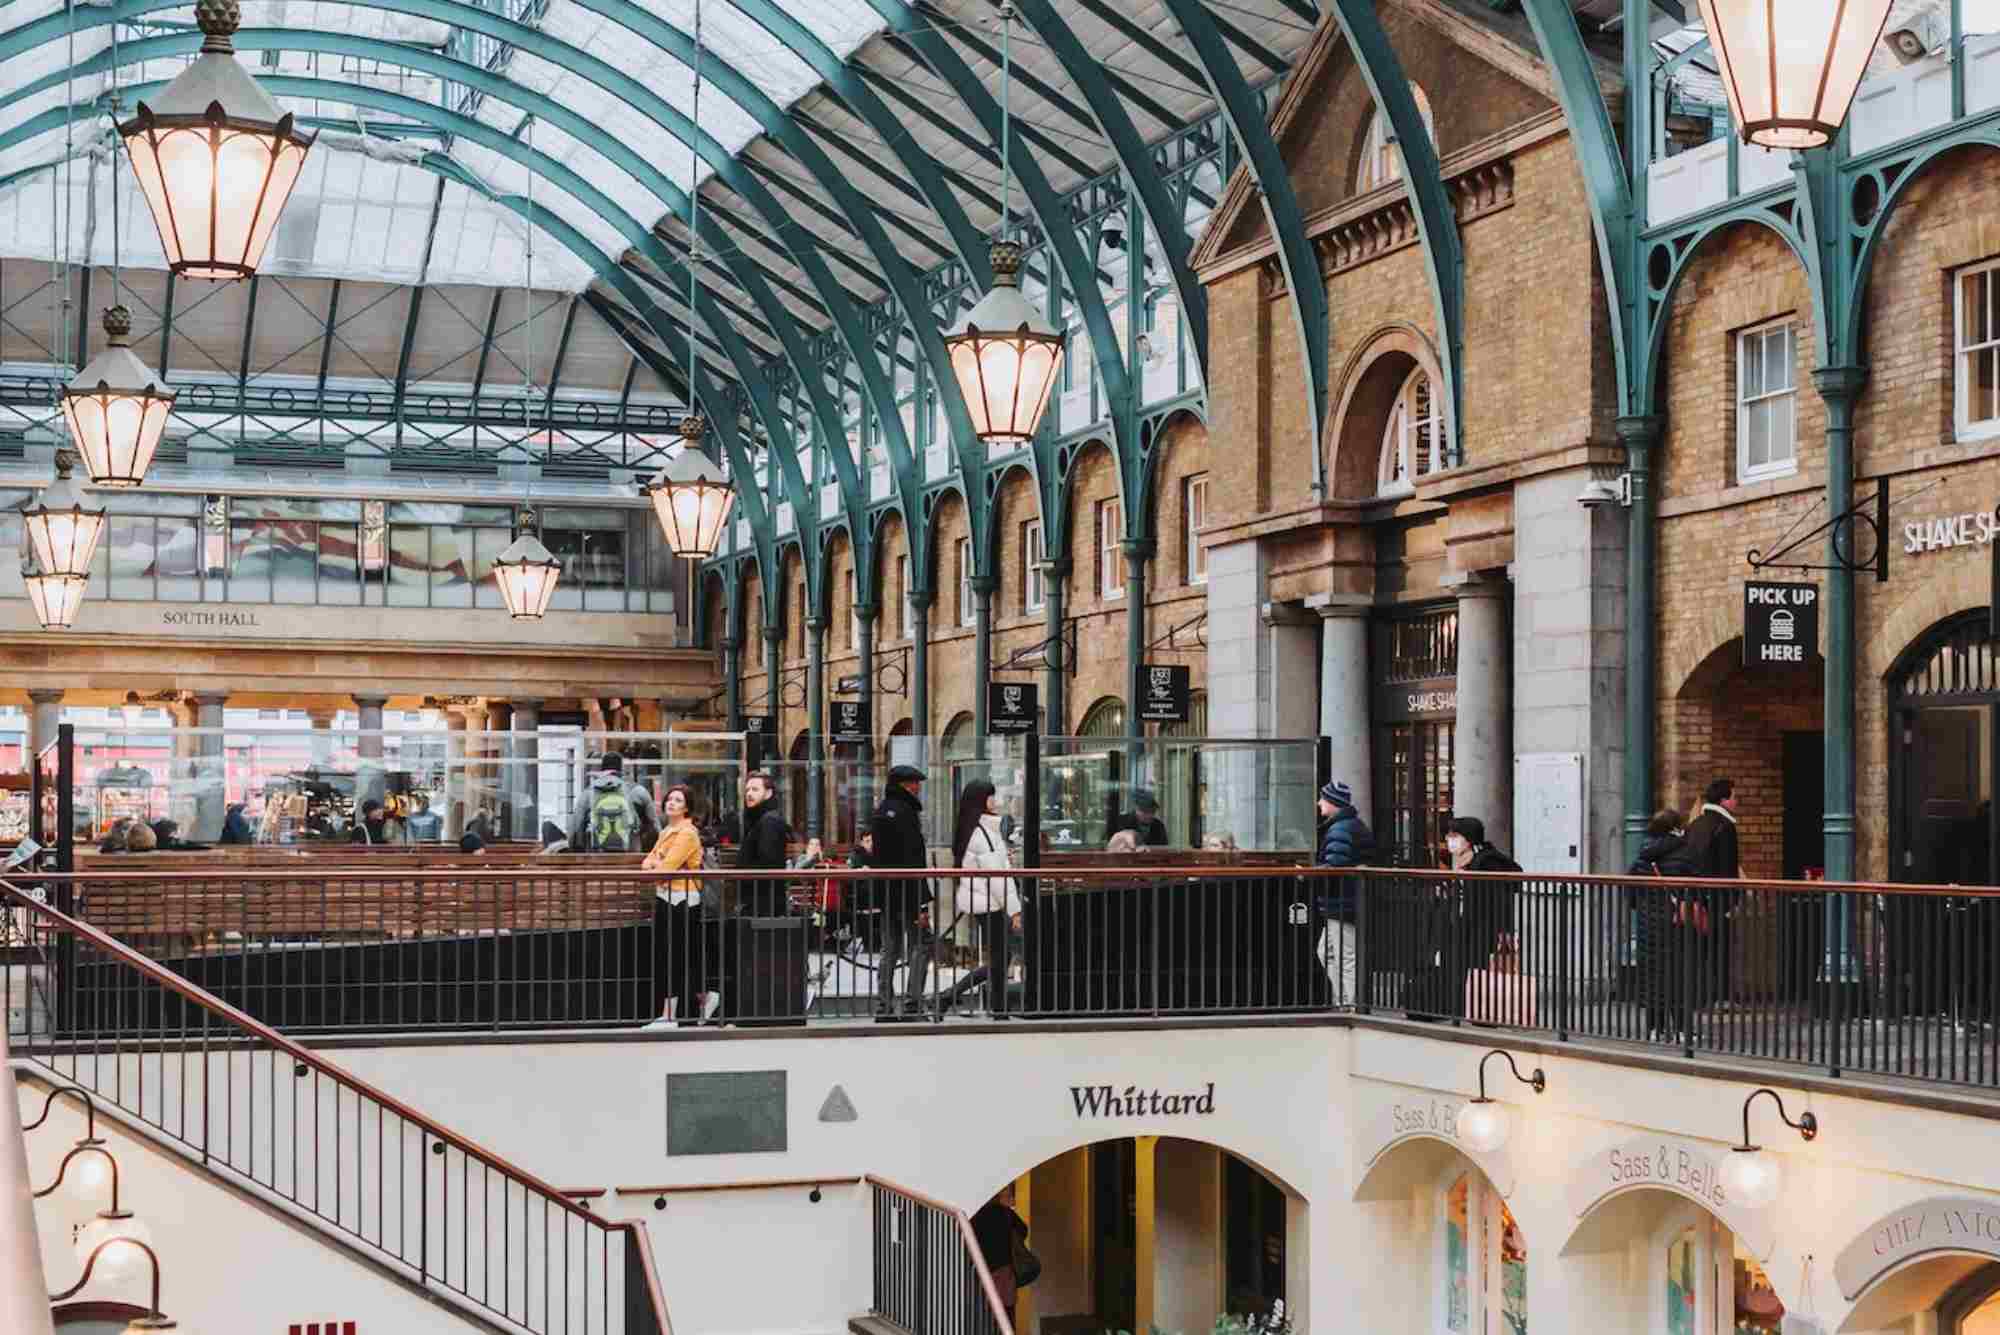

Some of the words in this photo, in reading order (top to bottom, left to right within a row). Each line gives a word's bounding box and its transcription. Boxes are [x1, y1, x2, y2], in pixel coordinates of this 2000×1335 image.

[1904, 514, 1974, 553] SHAKE
[1748, 588, 1787, 605] PICK
[1792, 589, 1816, 605] UP
[162, 611, 214, 625] SOUTH
[218, 612, 260, 626] HALL
[1761, 644, 1803, 661] HERE
[1437, 690, 1457, 710] SHA
[1070, 1082, 1216, 1118] Whittard
[1392, 1104, 1424, 1133] Sass
[1608, 1149, 1650, 1181] Sass
[1656, 1144, 1671, 1180] &
[1678, 1150, 1726, 1207] Belle
